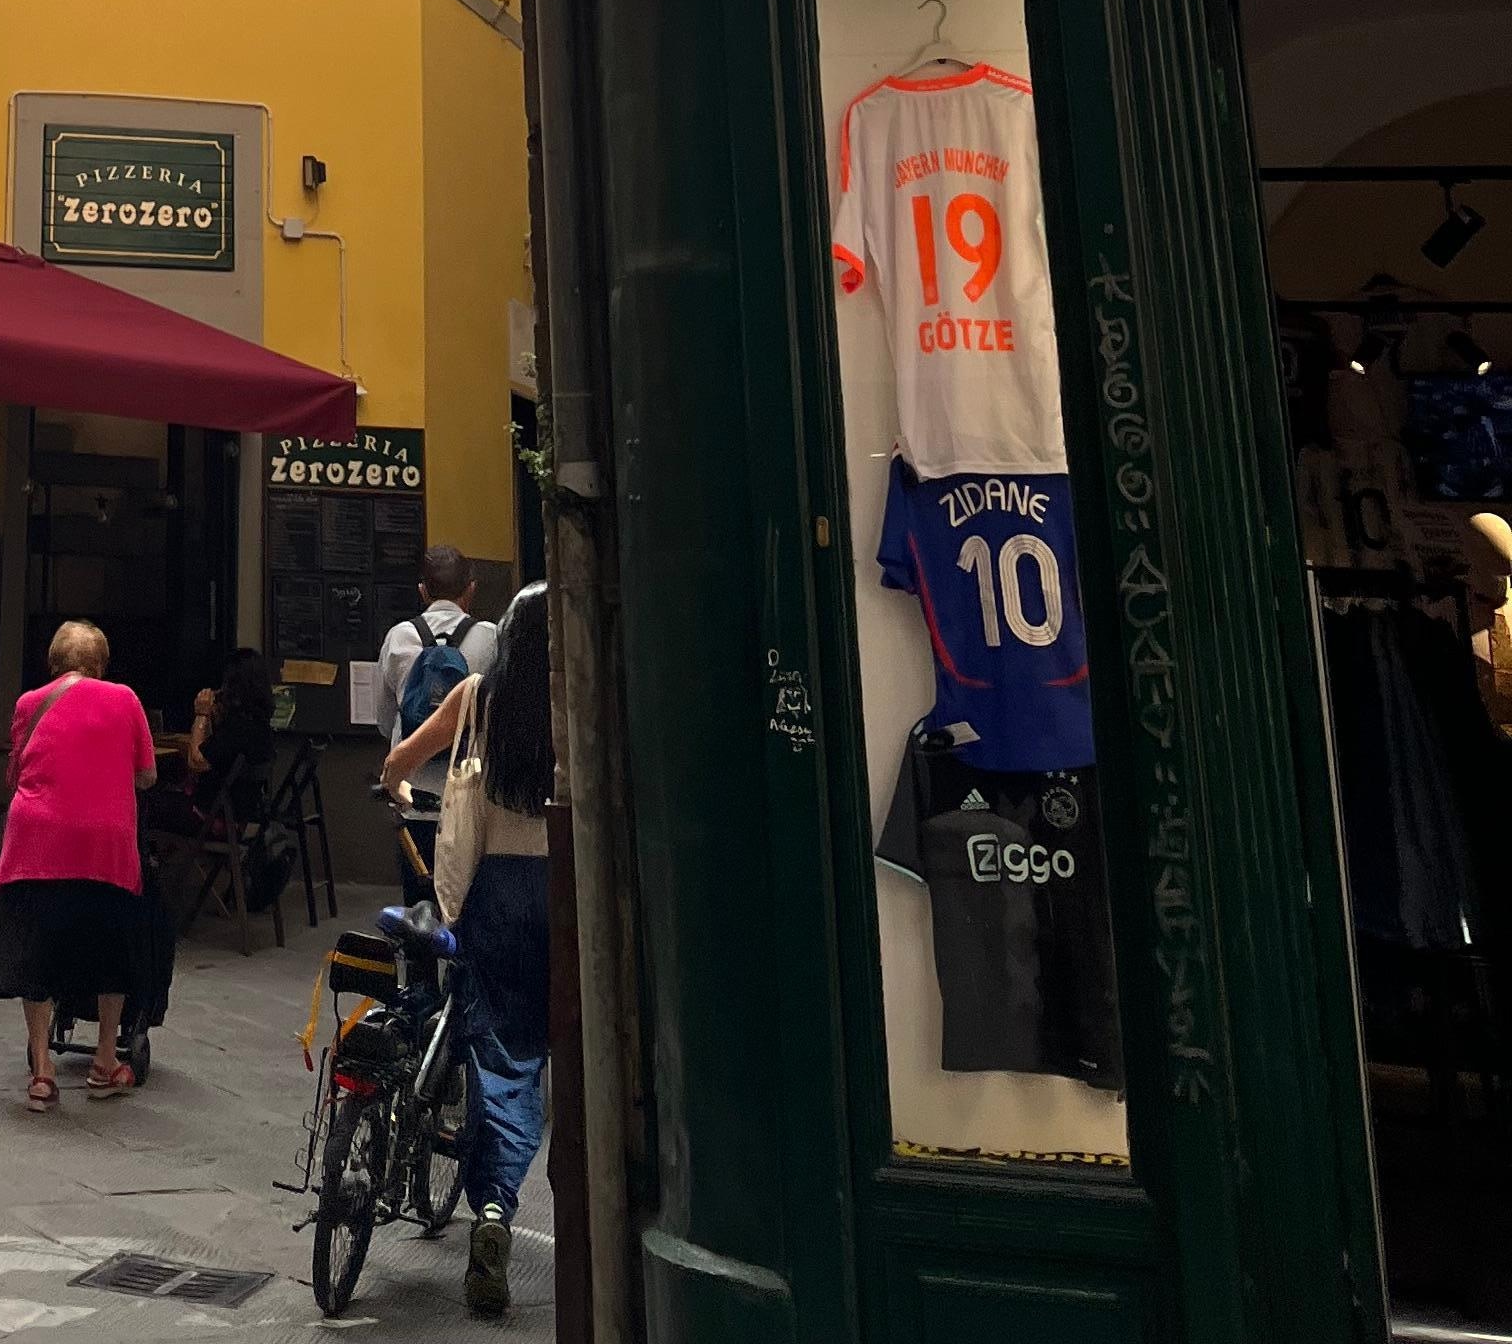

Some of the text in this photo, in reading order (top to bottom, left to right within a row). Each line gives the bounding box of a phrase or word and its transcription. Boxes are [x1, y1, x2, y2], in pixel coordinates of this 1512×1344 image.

[75, 164, 203, 195] PIZZERIA
[911, 192, 1003, 307] 19
[918, 310, 1016, 355] GÖTZE
[279, 433, 409, 464] PIZRIA
[938, 477, 1051, 528] ZIDANE
[956, 533, 1064, 648] 10
